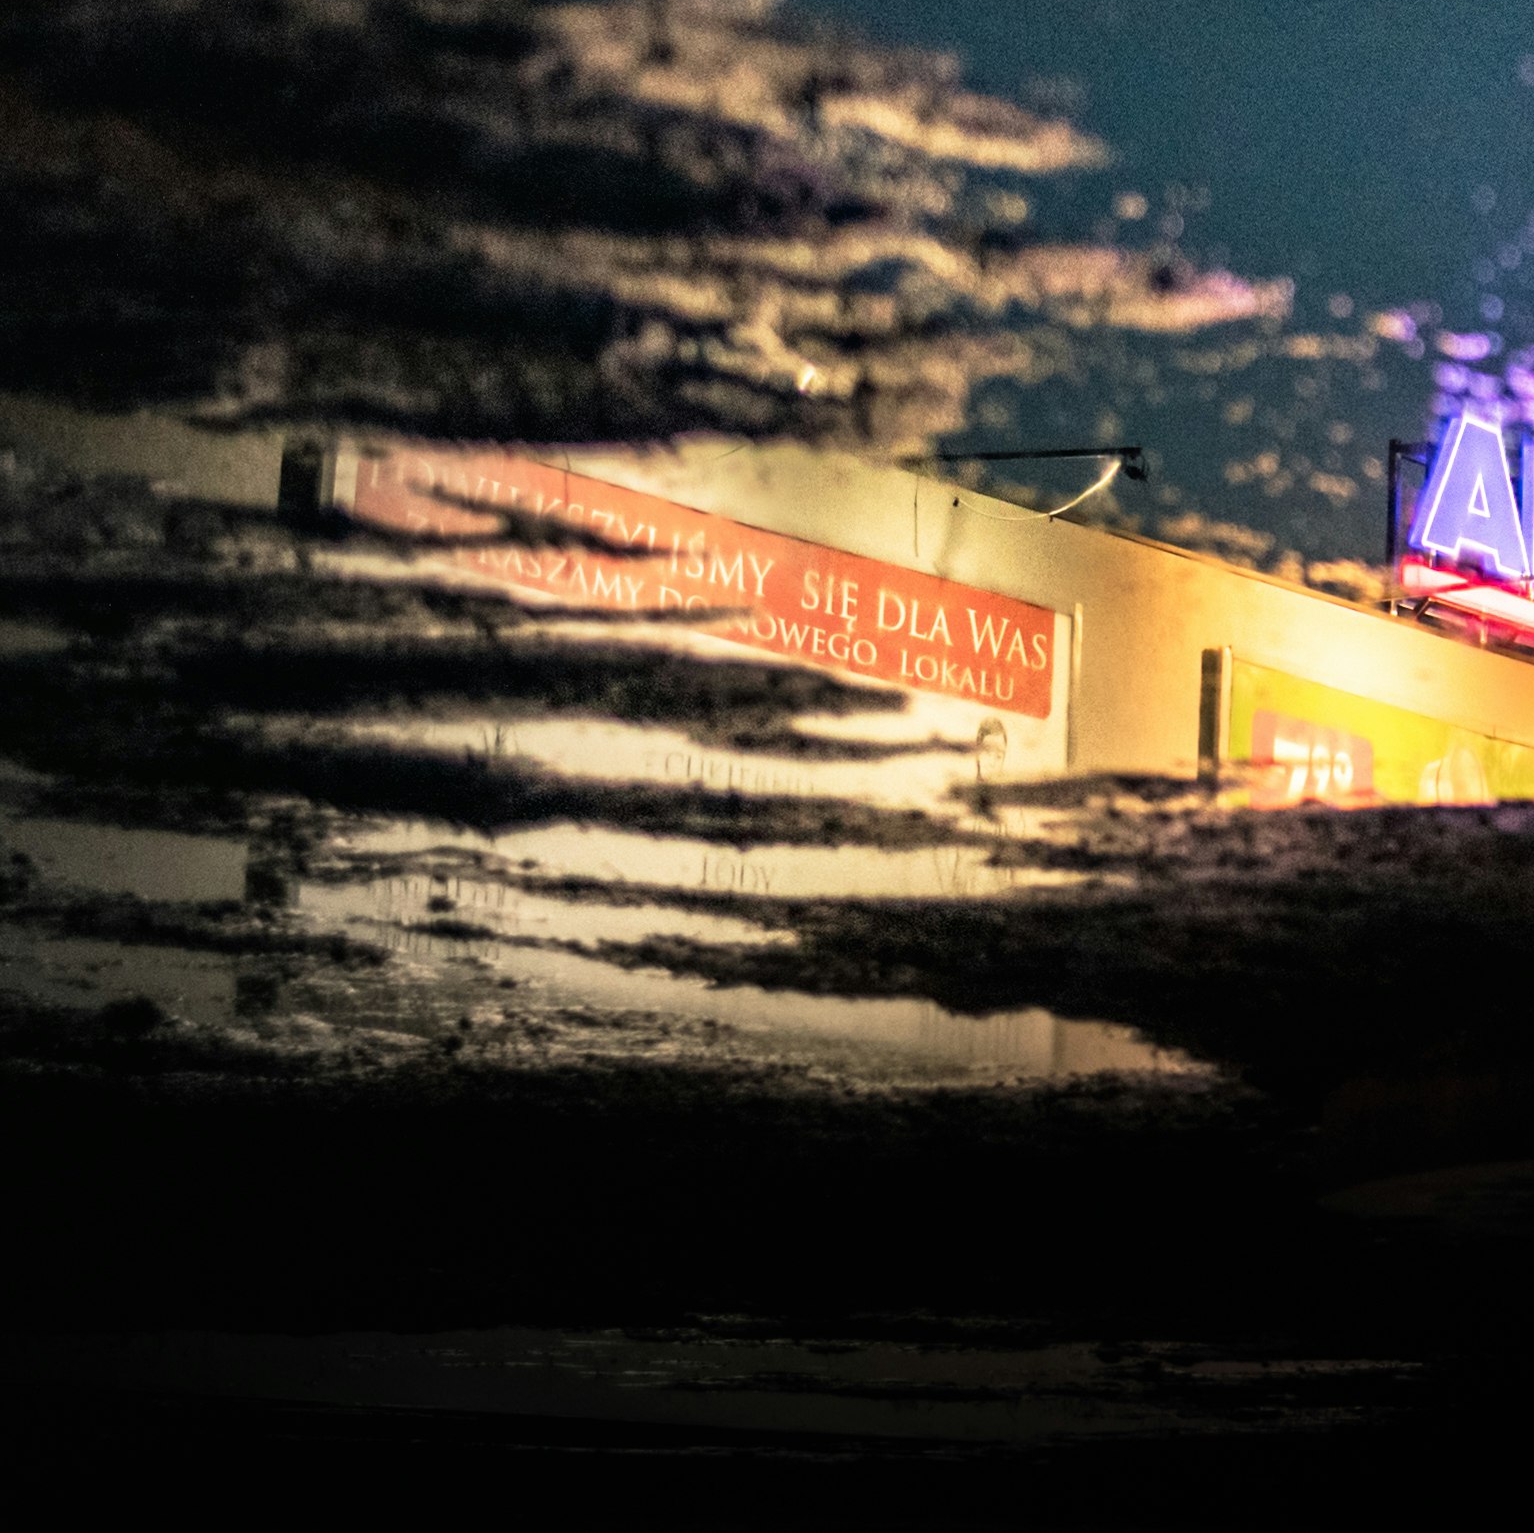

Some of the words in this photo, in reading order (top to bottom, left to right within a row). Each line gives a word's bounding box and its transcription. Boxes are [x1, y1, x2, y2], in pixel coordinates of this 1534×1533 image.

[800, 570, 860, 633] SIĘ
[877, 587, 954, 647] DLA
[966, 607, 1050, 670] WAS
[900, 649, 1015, 702] LOKALU
